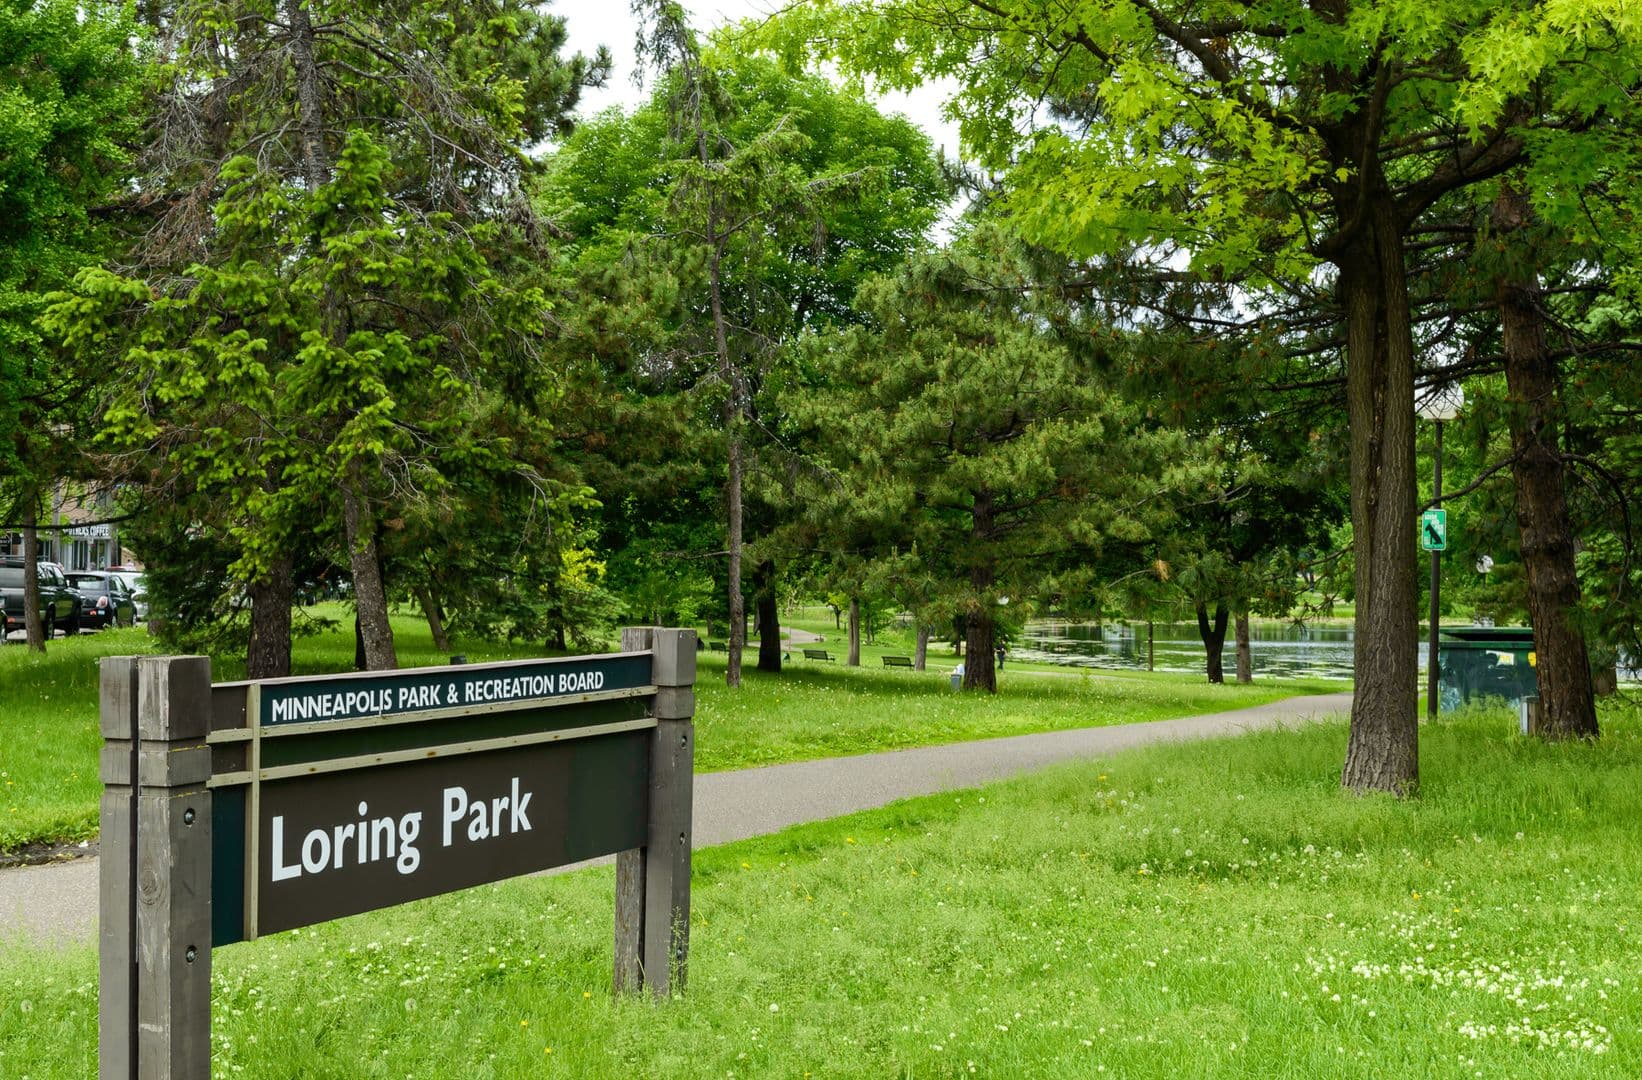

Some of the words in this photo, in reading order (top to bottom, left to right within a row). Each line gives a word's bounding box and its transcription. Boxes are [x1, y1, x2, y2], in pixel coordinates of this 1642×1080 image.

[90, 526, 109, 536] COFFEE
[272, 688, 392, 722] MINNEAPOLIS
[398, 684, 441, 709] PARK
[447, 683, 459, 704] &
[465, 674, 554, 700] RECREATION
[558, 671, 604, 692] BOARD
[271, 801, 422, 882] Loring
[442, 777, 533, 847] Park
